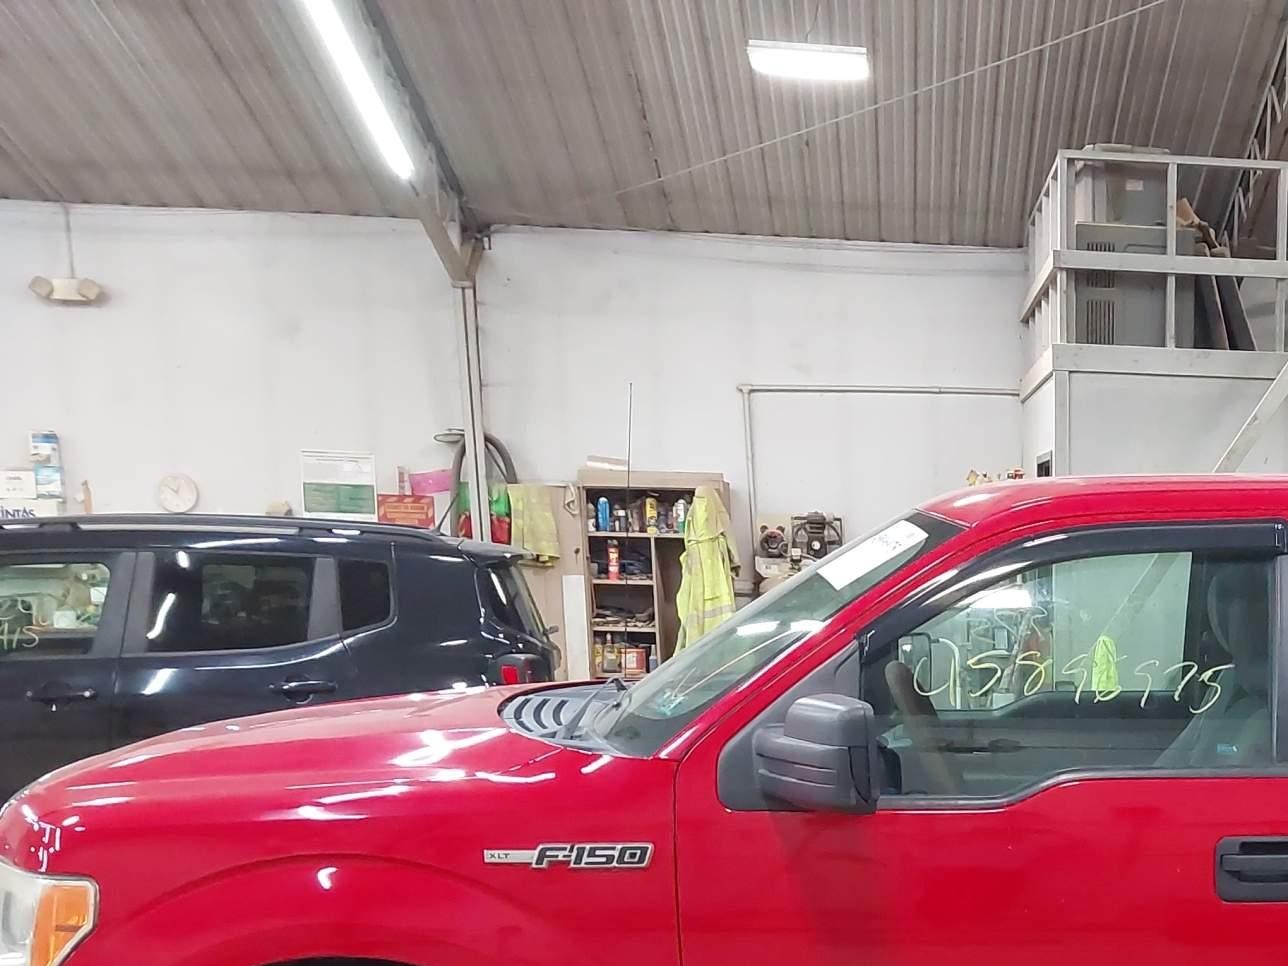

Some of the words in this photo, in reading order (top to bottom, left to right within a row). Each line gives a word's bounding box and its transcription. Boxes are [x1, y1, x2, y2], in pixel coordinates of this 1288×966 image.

[0, 505, 36, 518] INTAS
[488, 852, 511, 860] XLT
[532, 842, 654, 869] F-150
